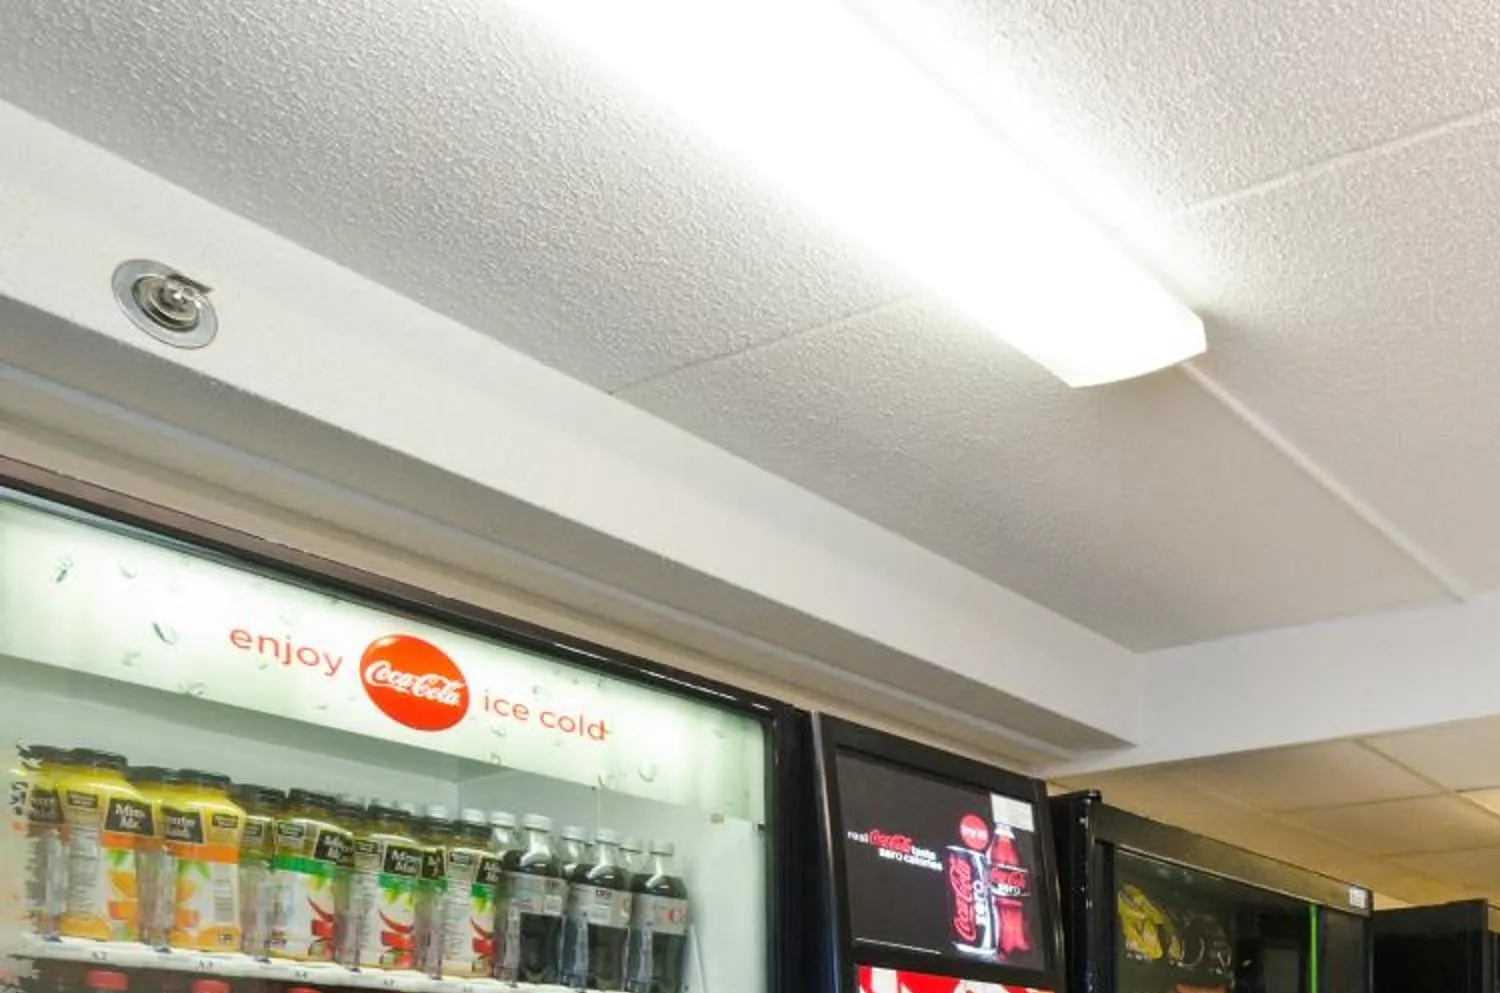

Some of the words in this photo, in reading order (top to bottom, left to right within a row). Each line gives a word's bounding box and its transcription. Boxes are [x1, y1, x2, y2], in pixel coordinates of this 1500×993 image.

[229, 627, 344, 678] enjoy
[483, 689, 530, 722] ice
[539, 707, 608, 742] cold
